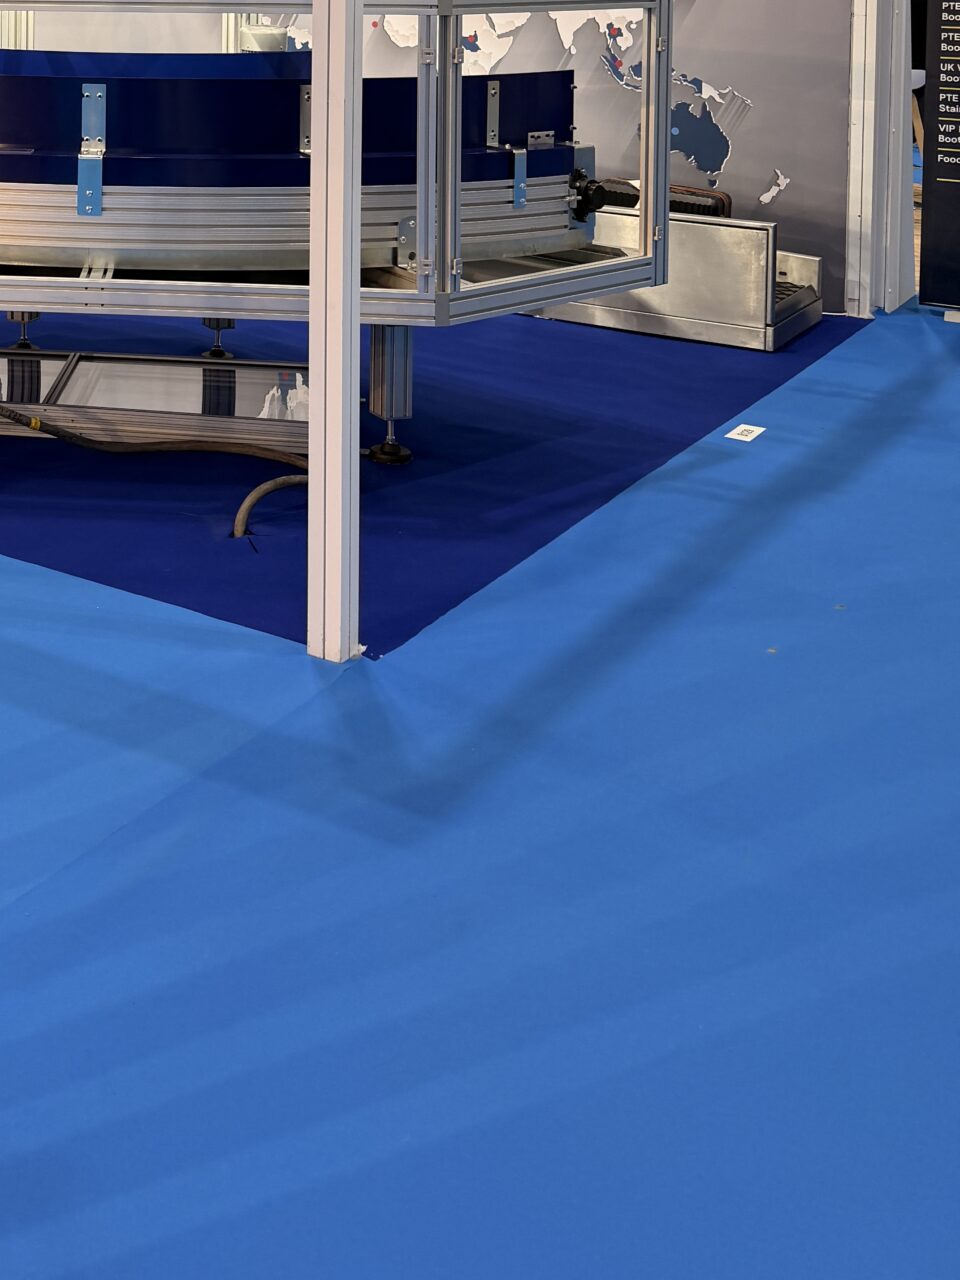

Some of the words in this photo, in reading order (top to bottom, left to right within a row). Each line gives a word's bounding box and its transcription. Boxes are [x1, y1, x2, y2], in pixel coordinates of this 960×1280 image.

[940, 63, 955, 71] UK
[940, 73, 960, 82] Boo
[939, 93, 959, 102] PTE
[938, 124, 956, 132] VIP
